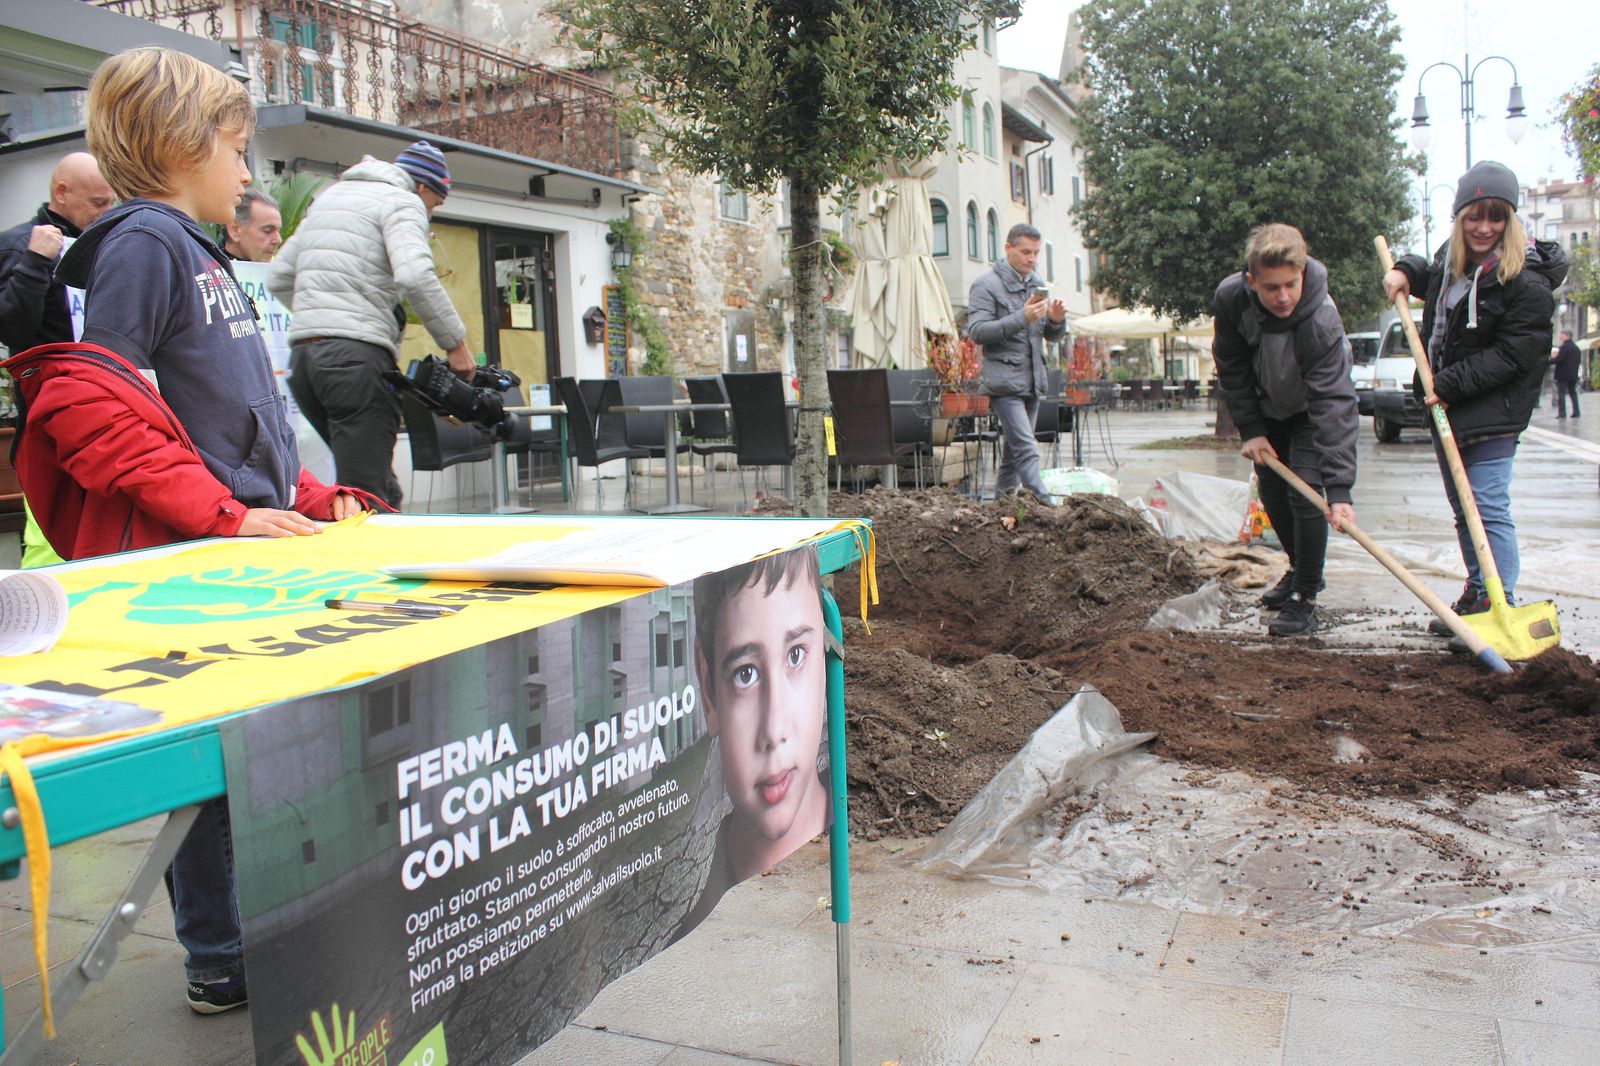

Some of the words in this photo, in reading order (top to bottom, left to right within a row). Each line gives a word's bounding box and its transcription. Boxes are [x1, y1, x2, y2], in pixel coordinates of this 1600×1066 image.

[397, 722, 518, 800] FERMA
[399, 802, 433, 847] IL
[440, 731, 590, 825] CONSUMO
[594, 715, 618, 756] DI
[622, 684, 696, 741] SUOLO
[401, 825, 480, 891] CON
[489, 805, 532, 853] LA
[536, 774, 588, 827] TUA
[591, 736, 667, 798] FIRMA
[405, 898, 444, 935] Ogni
[448, 876, 501, 915] giorno
[505, 865, 514, 886] il
[517, 849, 553, 879] suolo
[556, 839, 564, 857] è
[566, 810, 615, 851] soffocato,
[617, 778, 680, 818] avvelenato,
[407, 911, 482, 963] sfruttato.
[484, 883, 537, 920] Stanno
[539, 835, 608, 891] consumando
[609, 825, 616, 844] il
[618, 810, 655, 838] nostro
[657, 791, 690, 819] futuro.
[409, 957, 442, 989] Non
[446, 914, 521, 969] possiamo
[525, 866, 594, 924] permetterlo.
[411, 974, 456, 1014] Firma
[460, 963, 474, 984] la
[479, 924, 547, 977] petizione
[549, 912, 564, 932] su
[566, 845, 663, 920] www.salvailsuolo.it
